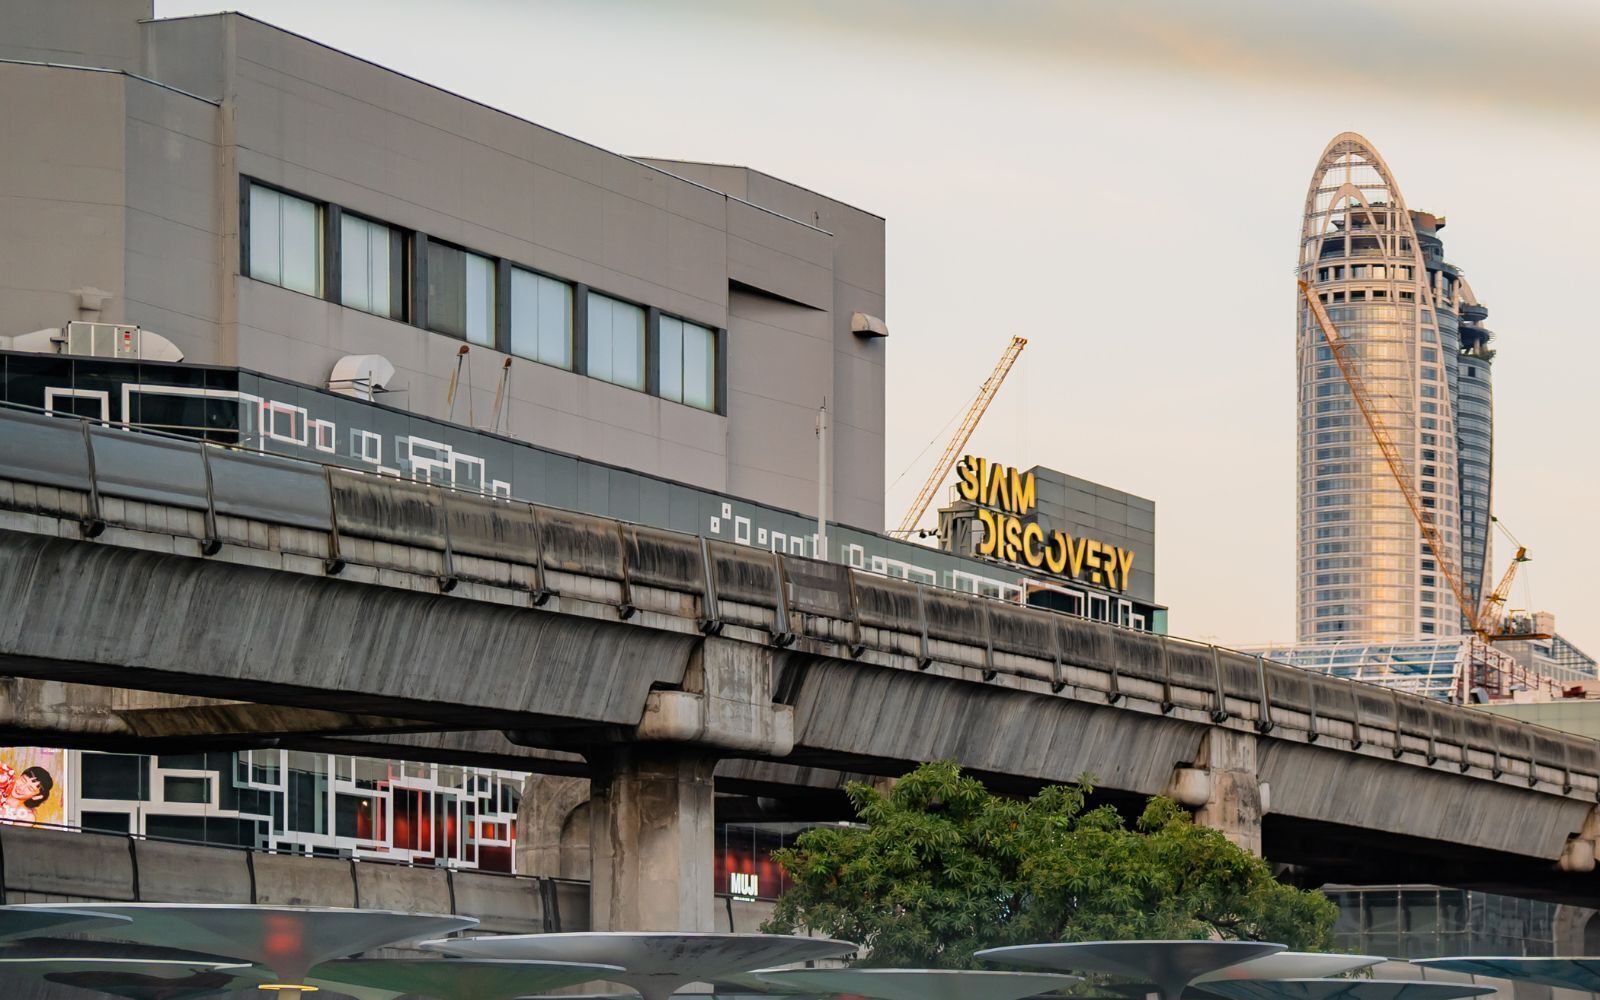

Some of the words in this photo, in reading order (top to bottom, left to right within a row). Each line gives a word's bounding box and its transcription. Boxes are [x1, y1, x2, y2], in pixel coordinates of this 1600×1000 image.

[957, 455, 1035, 515] SIAM
[976, 508, 1135, 593] DISCOVERY
[731, 872, 758, 896] MUJI
